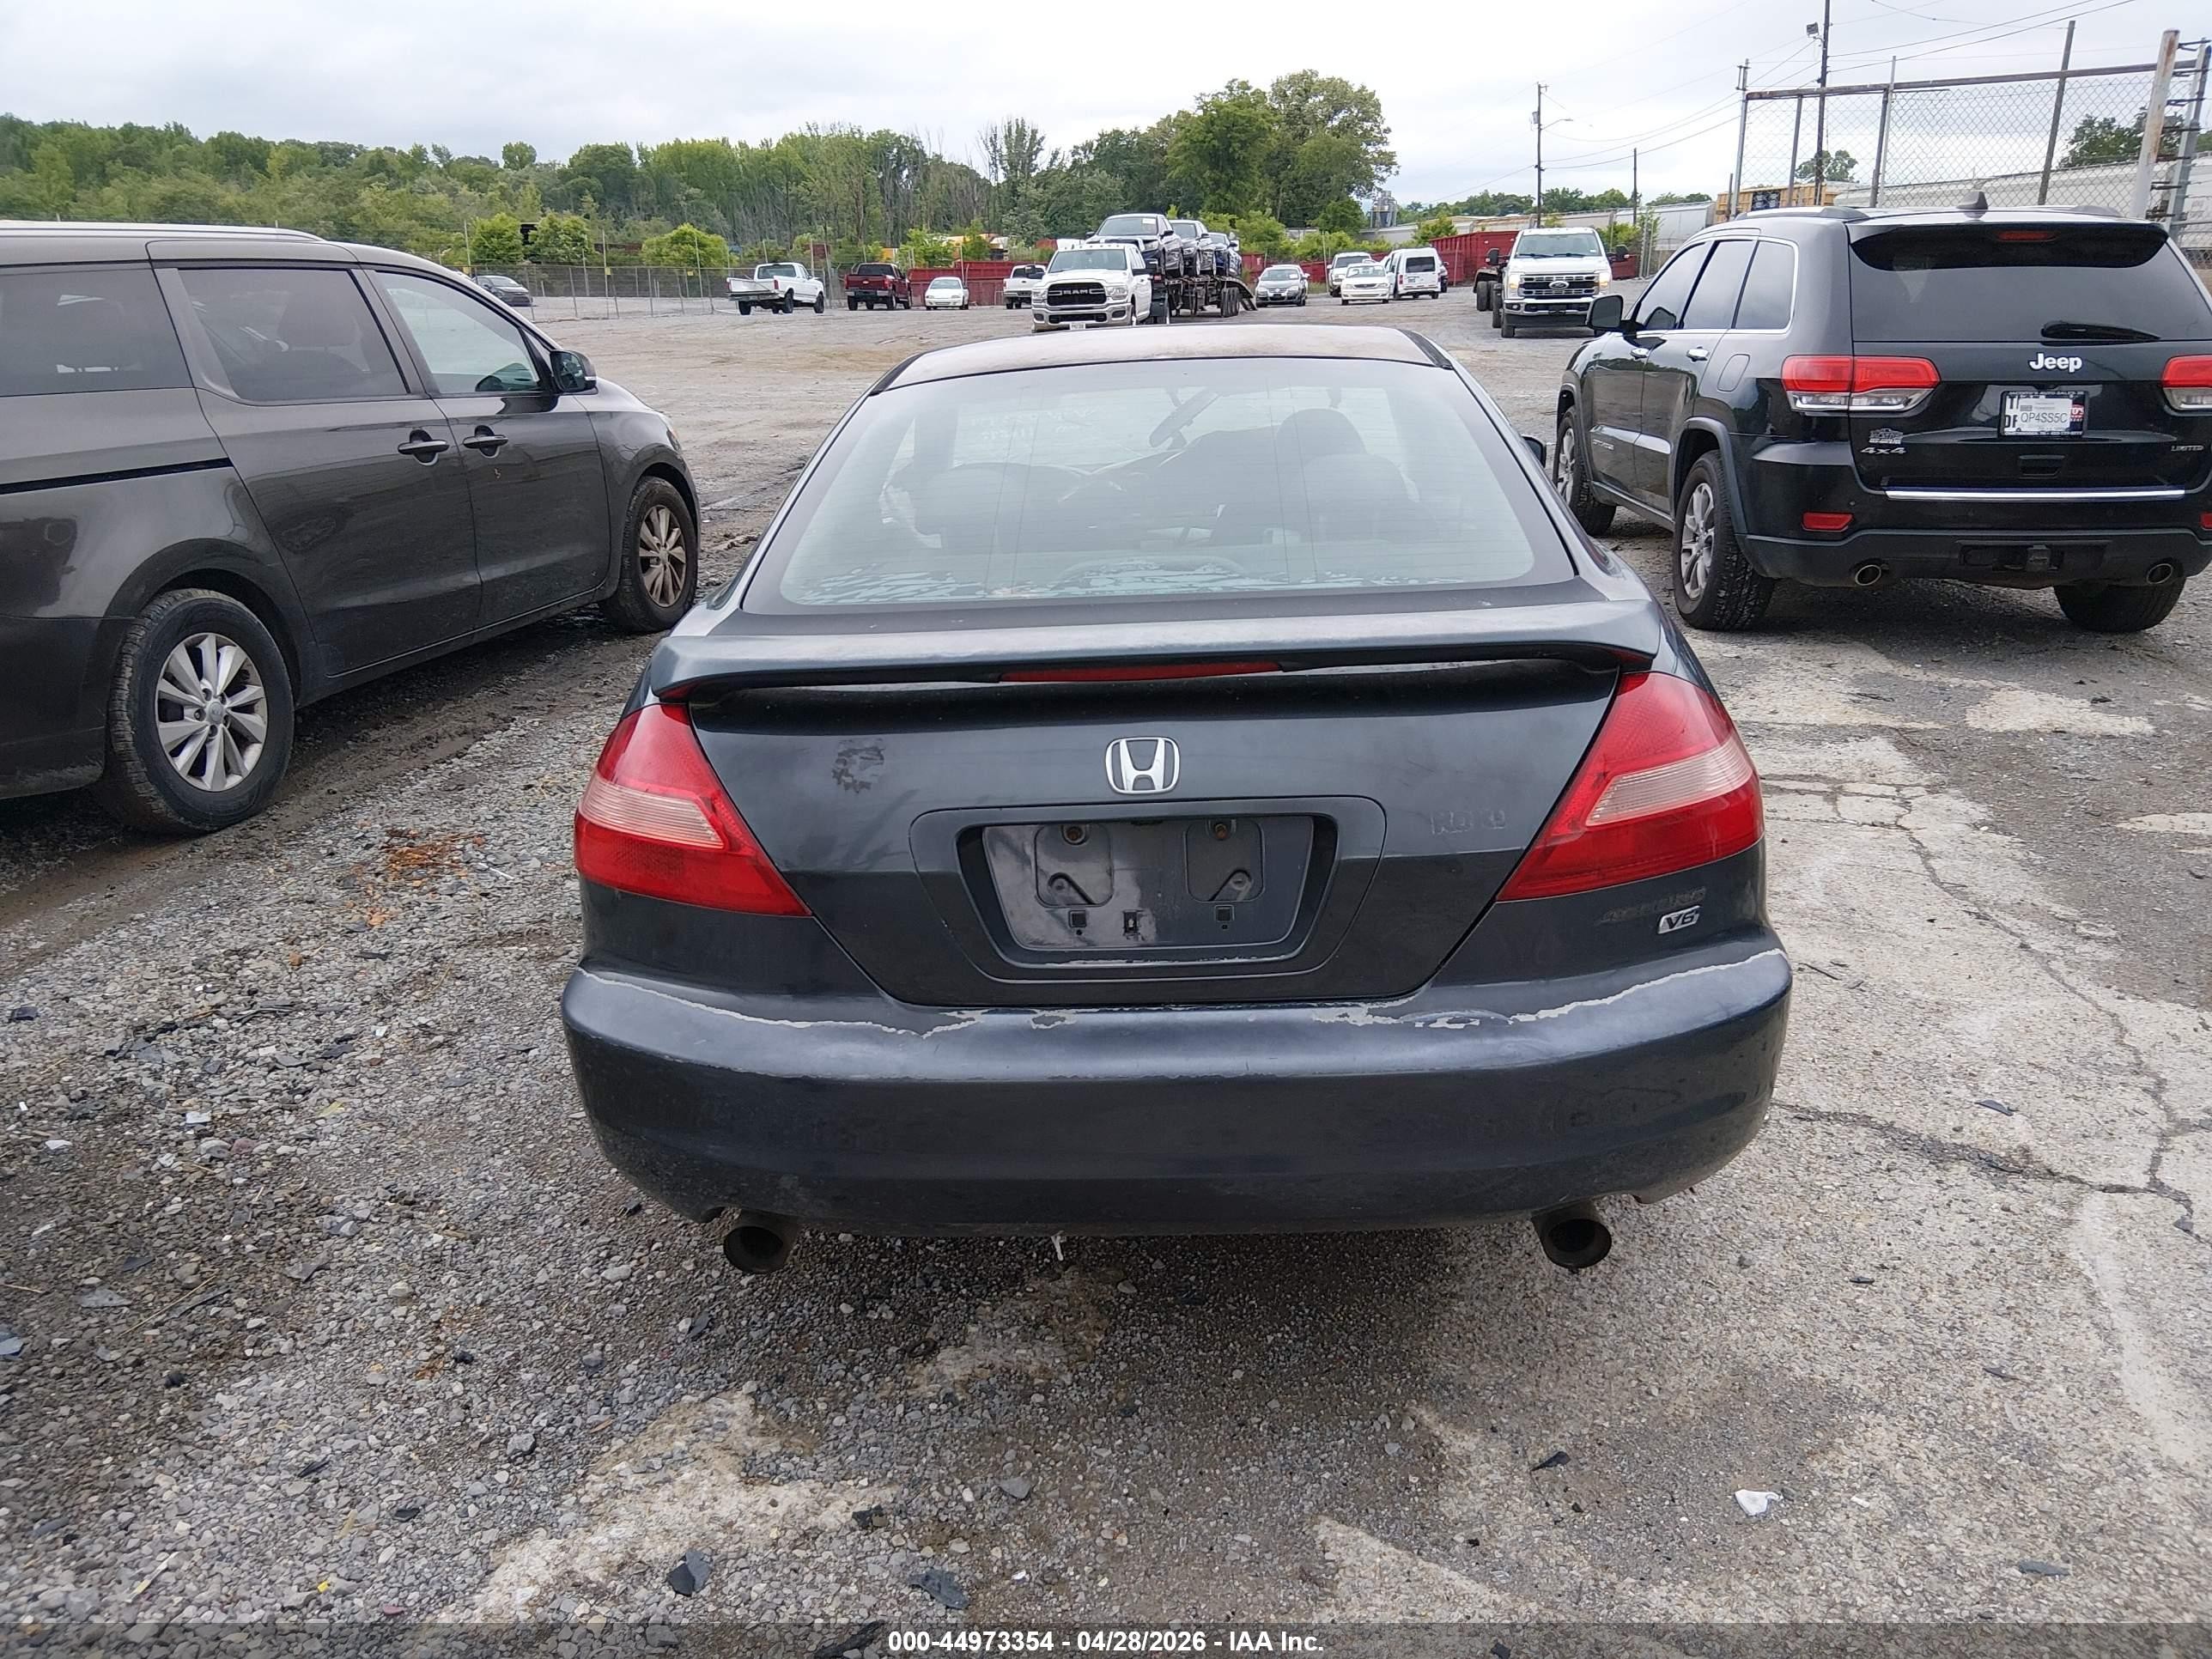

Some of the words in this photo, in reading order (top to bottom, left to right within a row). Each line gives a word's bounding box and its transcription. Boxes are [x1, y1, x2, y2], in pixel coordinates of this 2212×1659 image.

[2028, 352, 2082, 373] Jeep
[2020, 412, 2069, 423] QP4SS5C
[1665, 908, 1698, 931] V6
